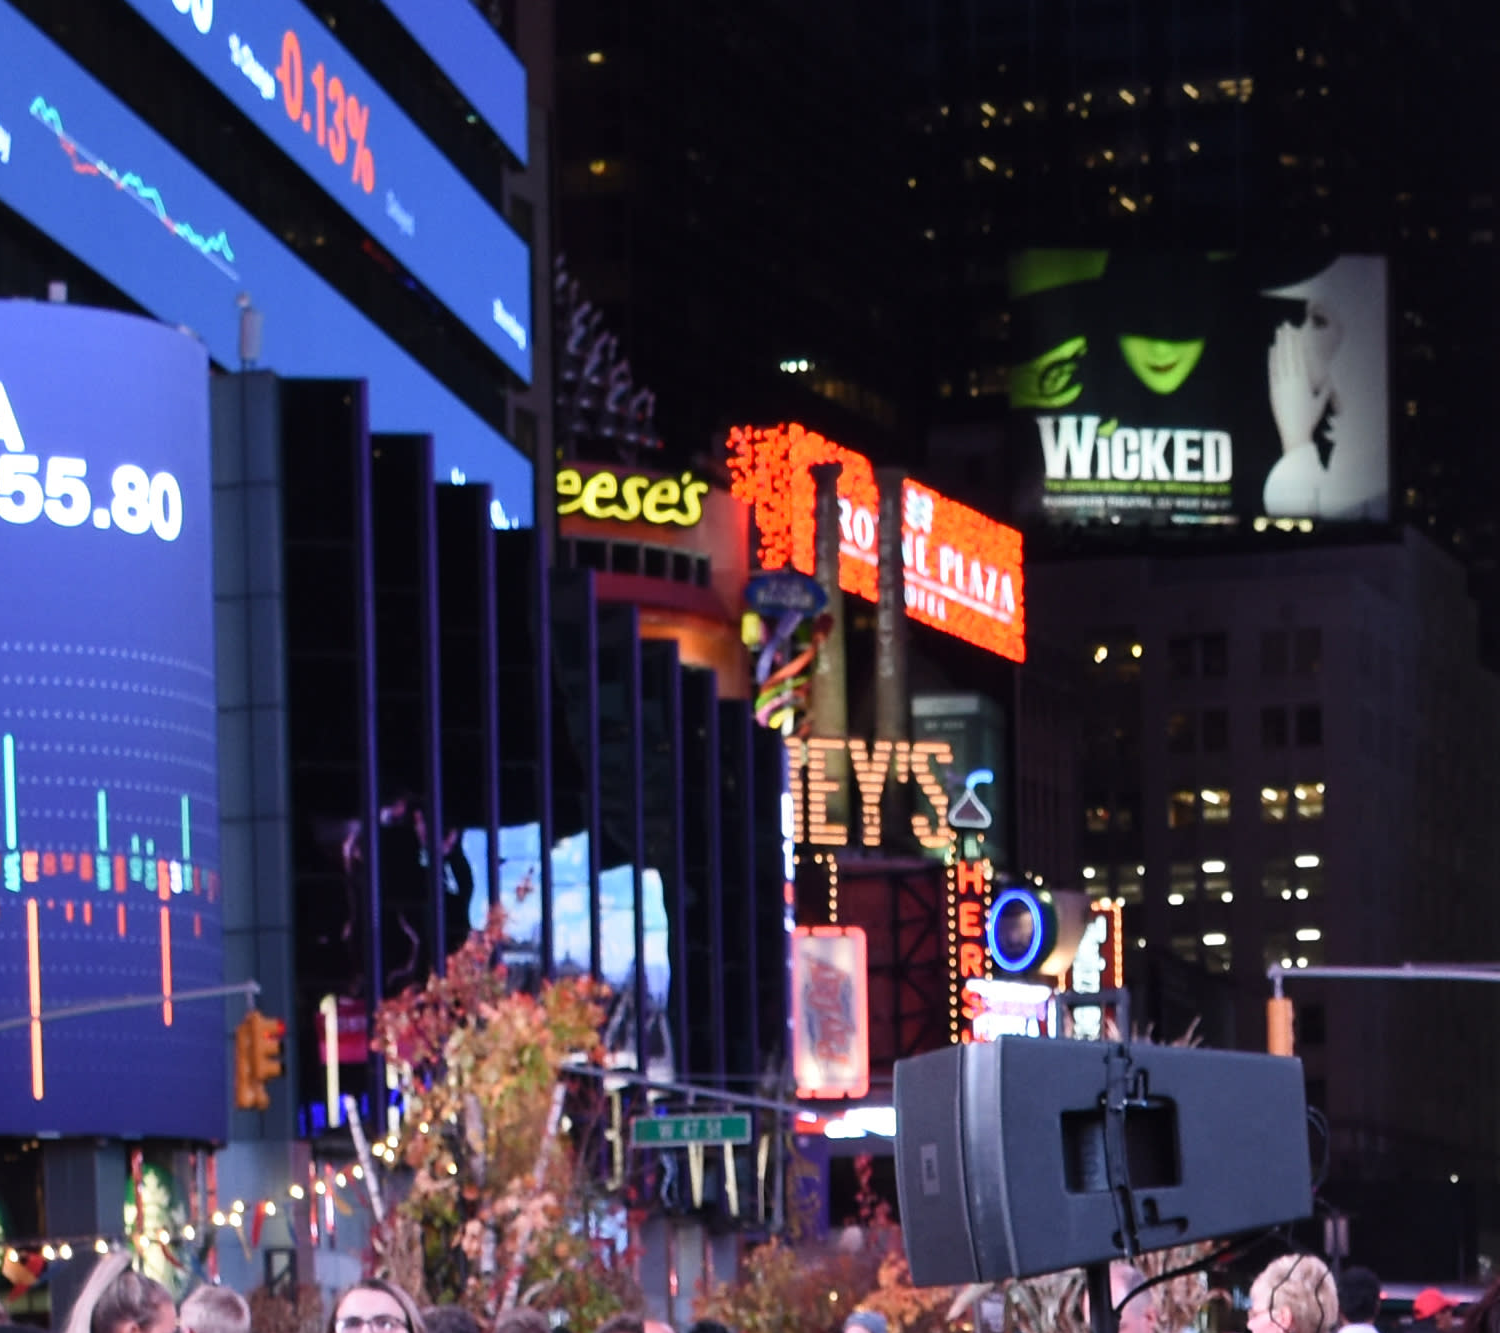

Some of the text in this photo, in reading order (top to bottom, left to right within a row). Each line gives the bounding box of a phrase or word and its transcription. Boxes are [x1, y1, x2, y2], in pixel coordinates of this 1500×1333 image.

[275, 29, 375, 195] -0.13%
[556, 467, 709, 527] eese's
[939, 545, 1016, 615] PLAZA
[658, 1119, 674, 1139] W
